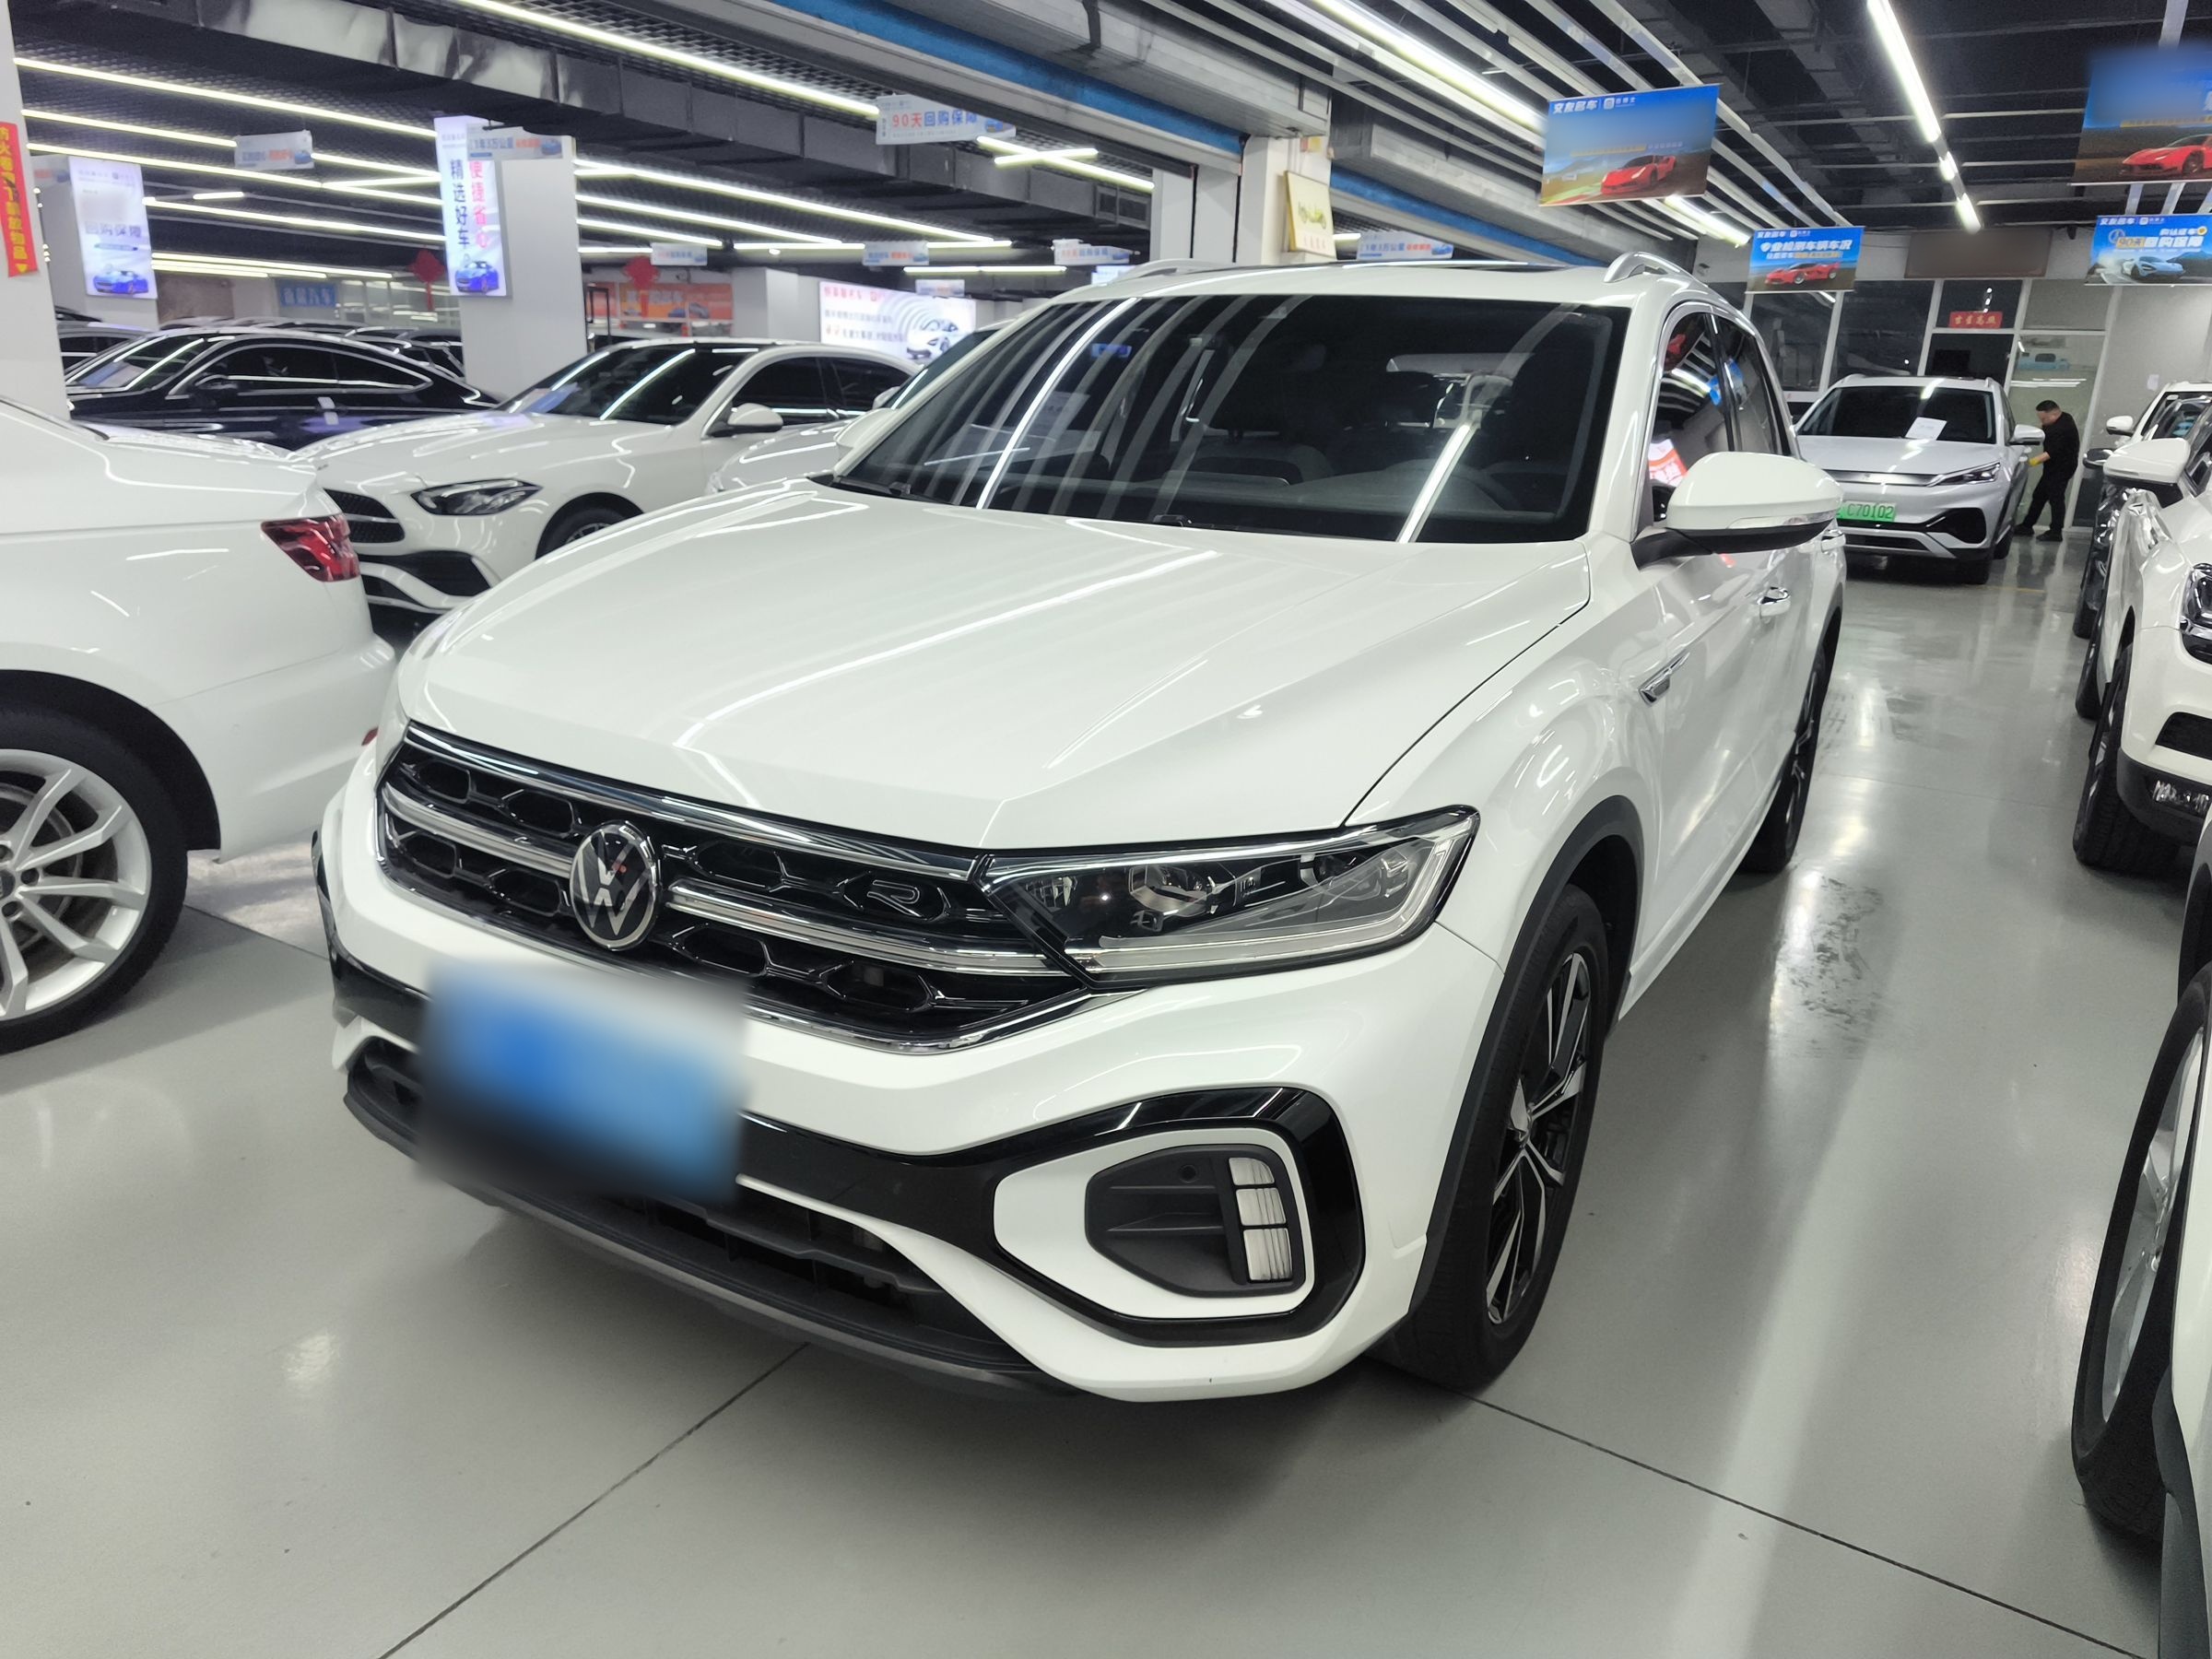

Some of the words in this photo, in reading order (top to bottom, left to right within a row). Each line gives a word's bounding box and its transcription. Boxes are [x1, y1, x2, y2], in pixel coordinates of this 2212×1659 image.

[891, 109, 978, 128] 90天回购保障
[450, 159, 470, 249] 精选好车
